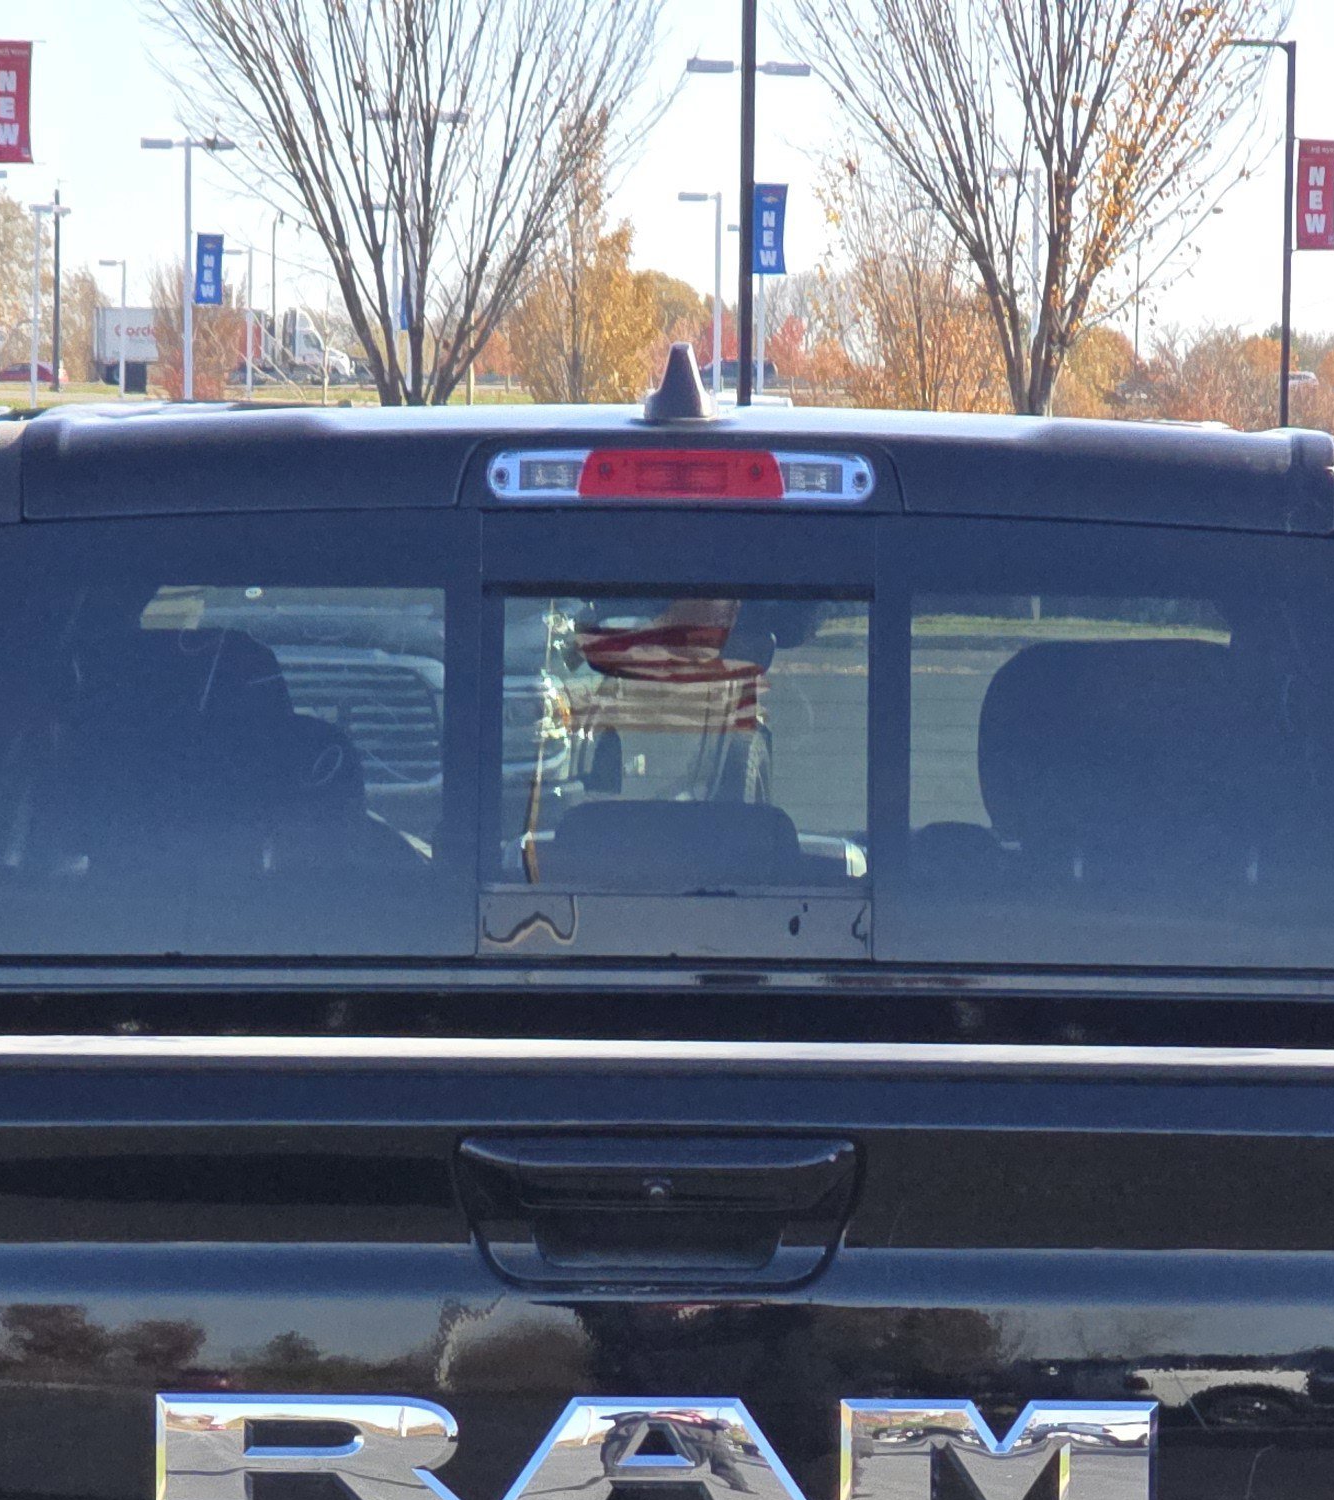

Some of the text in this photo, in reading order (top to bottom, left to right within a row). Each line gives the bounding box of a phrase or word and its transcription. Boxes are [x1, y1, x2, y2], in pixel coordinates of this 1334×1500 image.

[1305, 166, 1326, 234] NEW
[760, 210, 777, 267] NEW
[200, 253, 216, 298] NEW
